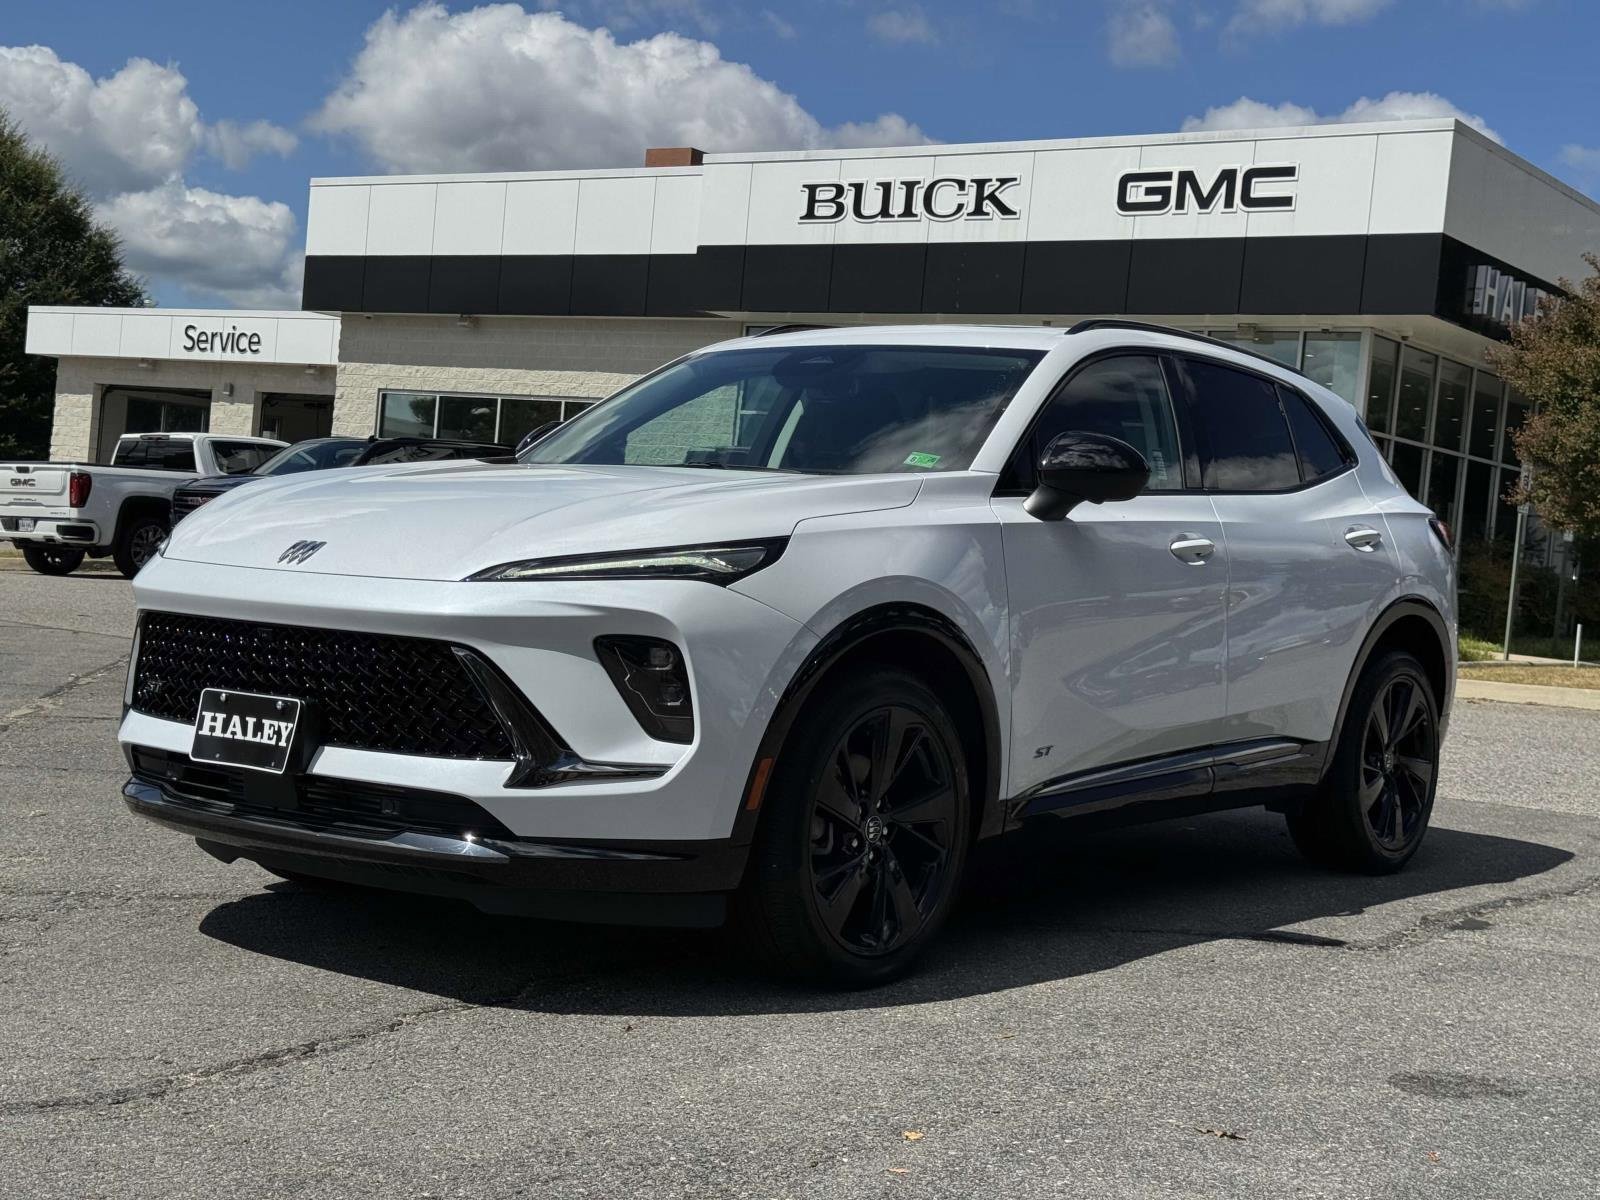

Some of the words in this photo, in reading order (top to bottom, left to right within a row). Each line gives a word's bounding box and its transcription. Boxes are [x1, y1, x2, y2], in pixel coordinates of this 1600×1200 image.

[799, 176, 1020, 222] BUICK
[1116, 164, 1297, 214] GMC
[183, 324, 262, 354] Service
[10, 478, 36, 487] GMC
[198, 711, 294, 747] HALEY
[1033, 744, 1055, 759] ST
